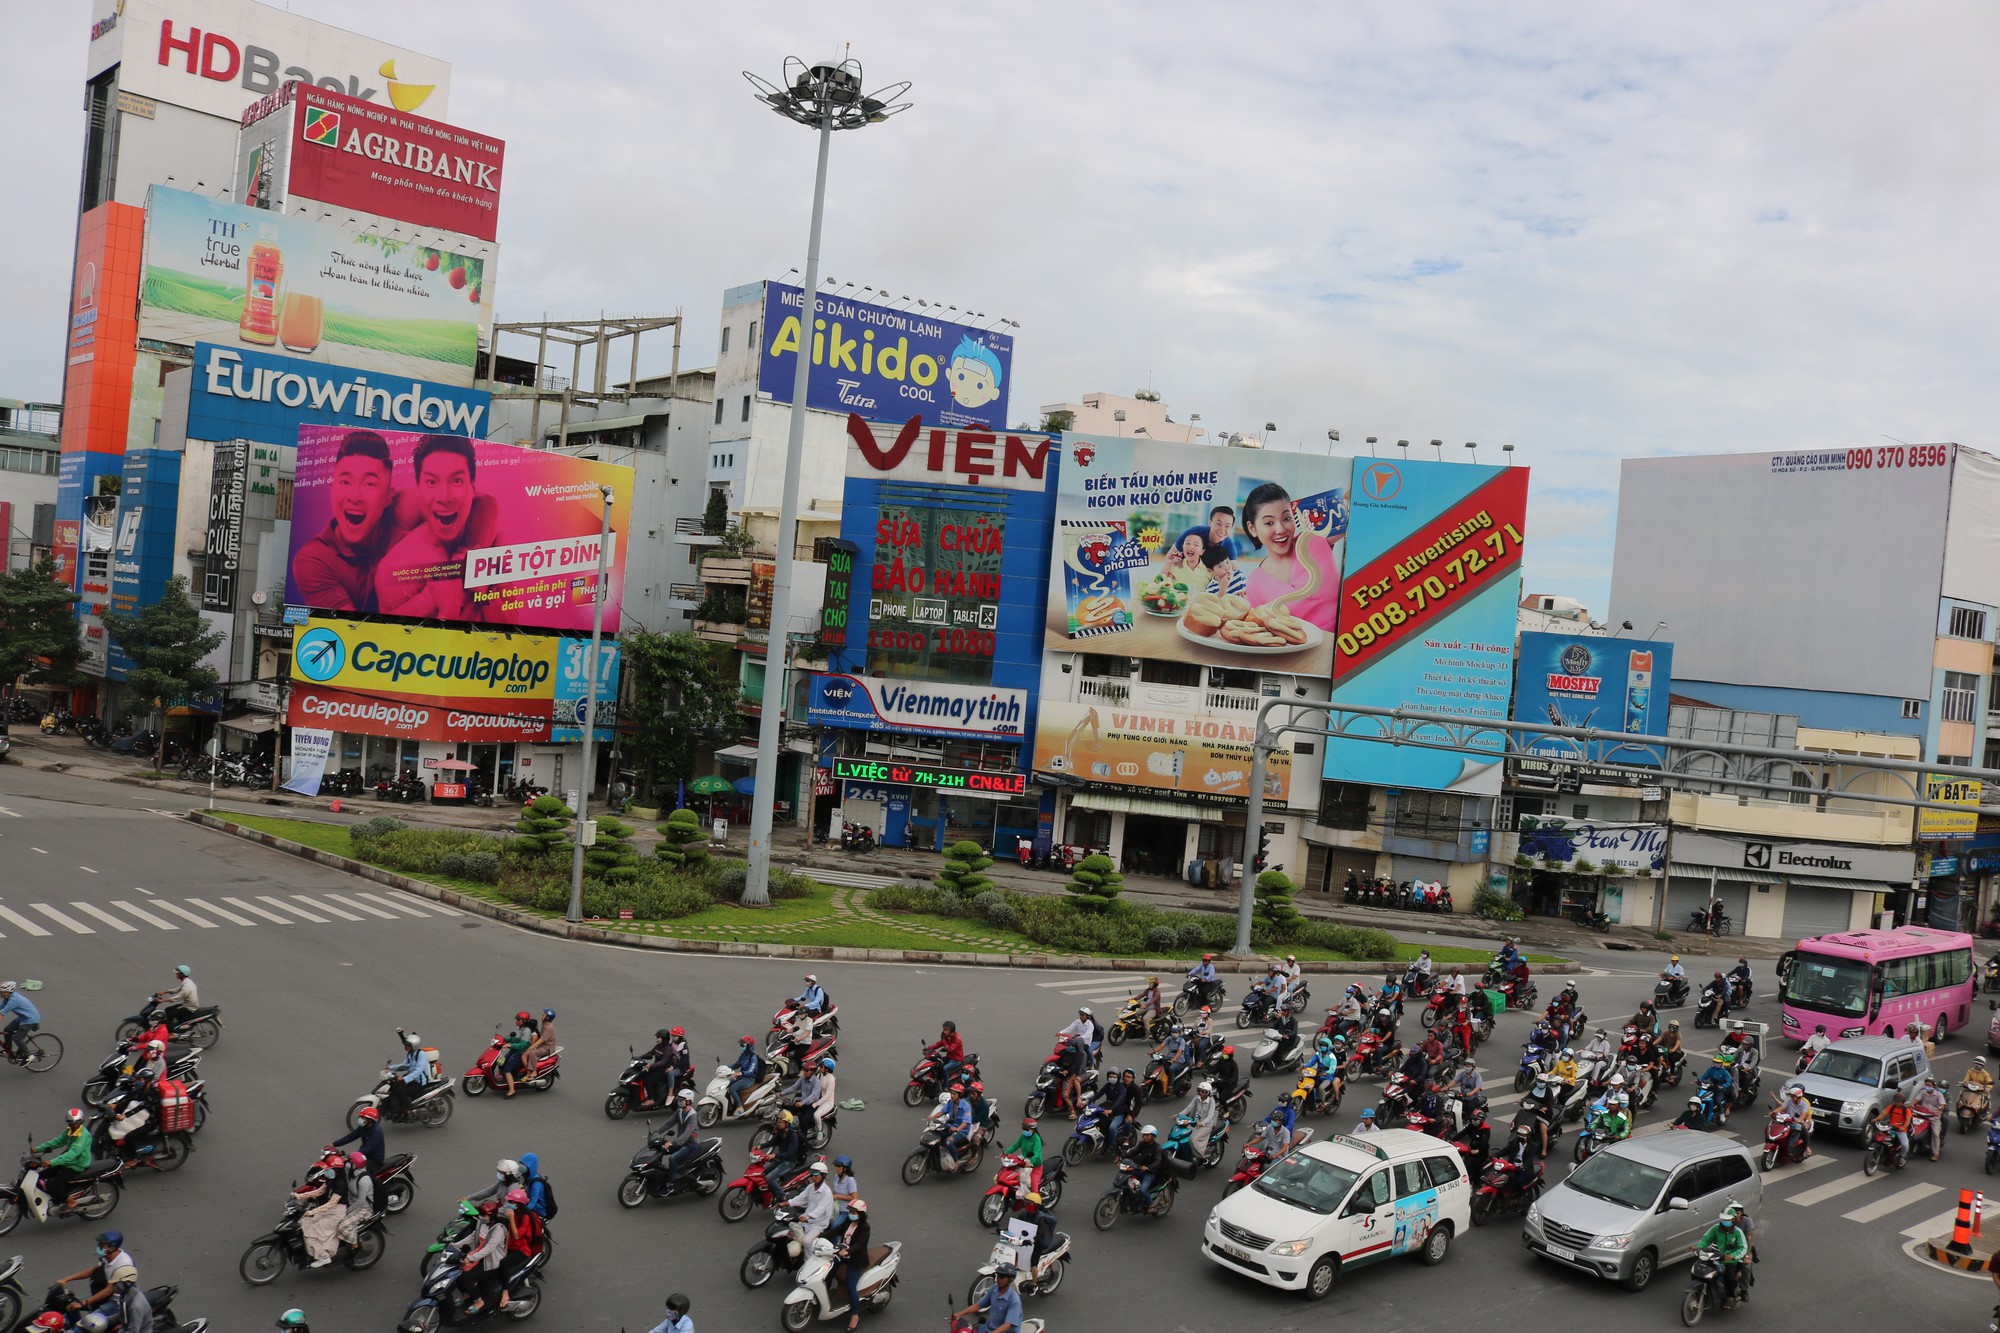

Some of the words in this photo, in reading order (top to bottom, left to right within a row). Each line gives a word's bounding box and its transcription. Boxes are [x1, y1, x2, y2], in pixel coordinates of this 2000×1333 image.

[327, 98, 345, 112] HÀNG
[347, 104, 365, 117] NÔNG
[366, 110, 388, 124] NGHIỆP
[390, 116, 397, 126] VÀ
[400, 119, 414, 131] PHÁT
[417, 124, 434, 136] TRIỂN
[435, 129, 452, 140] NÔNG
[454, 134, 469, 146] THÔN
[471, 139, 483, 151] VIỆT
[485, 144, 499, 154] NAM
[343, 127, 498, 193] AGRIBANK
[371, 171, 392, 185] Mang
[416, 182, 434, 194] thịnh
[452, 190, 474, 204] khách
[475, 195, 493, 210] hàng
[208, 218, 236, 238] TH
[206, 236, 240, 257] true
[201, 251, 240, 270] Herbal
[780, 291, 824, 312] MIẾG
[827, 299, 854, 320] DÁN
[858, 306, 906, 331] CHƯỜM
[909, 320, 942, 340] LẠNH
[770, 315, 938, 386] Aikido
[205, 348, 485, 438] Eurowindow
[836, 378, 875, 409] Tatra
[899, 384, 936, 404] COOL
[847, 412, 1050, 485] VIỆN
[1772, 456, 1784, 467] CTY.
[1786, 452, 1805, 466] QUẢNG
[1806, 452, 1818, 465] CÁO
[1818, 454, 1830, 465] KIM
[1830, 452, 1846, 464] MINH
[1846, 449, 1872, 470] 090
[1877, 446, 1904, 468] 370
[1908, 444, 1946, 468] 8596
[542, 480, 599, 496] vietnamobile
[1085, 473, 1116, 492] BIẾN
[1120, 471, 1149, 488] TẤU
[1152, 470, 1184, 488] MÓN
[1188, 470, 1218, 487] NHẸ
[1088, 494, 1126, 508] NGON
[1130, 489, 1160, 506] KHÓ
[1164, 487, 1213, 504] CƯỠNG
[876, 512, 921, 548] SỬA
[939, 518, 1003, 555] CHỮA
[1142, 533, 1160, 544] MỚI
[474, 550, 514, 578] PHÊ
[519, 546, 556, 576] TỘT
[830, 550, 851, 574] SỬA
[1127, 556, 1148, 567] mai
[1352, 575, 1392, 610] For
[1394, 509, 1493, 584] Advertising
[872, 548, 925, 594] BẢO
[934, 562, 1002, 600] HÀNH
[474, 590, 500, 603] Hoàn
[502, 586, 525, 598] toàn
[527, 581, 550, 594] miễn
[552, 578, 568, 592] phí
[829, 580, 848, 605] TẠI
[1336, 522, 1524, 658] 0908.70.72.71
[501, 600, 524, 612] data
[527, 596, 544, 609] và
[545, 593, 566, 610] gọi
[882, 604, 907, 618] PHONE
[915, 606, 944, 620] LAPTOP
[953, 610, 979, 623] TABLET
[867, 629, 926, 651] 1800
[936, 628, 996, 657] 1080
[1470, 642, 1484, 651] Thi
[1487, 644, 1510, 654] công:
[351, 640, 549, 690] Capcuulaptop
[1466, 660, 1496, 671] Mockup
[1564, 658, 1589, 668] Mosfly
[504, 683, 528, 694] .com
[1550, 674, 1600, 692] MOSFLY
[1416, 686, 1428, 694] Thi
[1483, 694, 1504, 702] Aluco
[302, 695, 429, 729] Capcuulaptop
[845, 709, 878, 720] Computer
[880, 684, 1020, 726] Vienmaytinh
[1400, 702, 1418, 710] Gian
[395, 722, 413, 730] .com
[870, 721, 884, 730] 265
[992, 722, 1018, 733] .com
[1112, 713, 1176, 735] VINH
[1107, 733, 1120, 742] PHỤ
[1123, 733, 1140, 742] TÙNG
[1142, 735, 1153, 744] CƠ
[1154, 735, 1168, 744] GIỚI
[1202, 741, 1215, 749] NHÀ
[1217, 742, 1234, 751] PHÂN
[1470, 738, 1500, 747] Outdoor
[1210, 752, 1224, 760] BƠM
[1270, 758, 1279, 767] TẠI
[1280, 758, 1292, 766] VN.
[1521, 760, 1549, 770] VIRUS
[838, 761, 888, 782] L.VIỆC
[892, 766, 912, 782] từ
[915, 771, 964, 788] 7H-21H
[443, 786, 459, 796] 367
[850, 787, 888, 804] 265
[1568, 825, 1622, 849] Hoa
[1620, 829, 1668, 862] My
[1778, 851, 1852, 871] Electrolux
